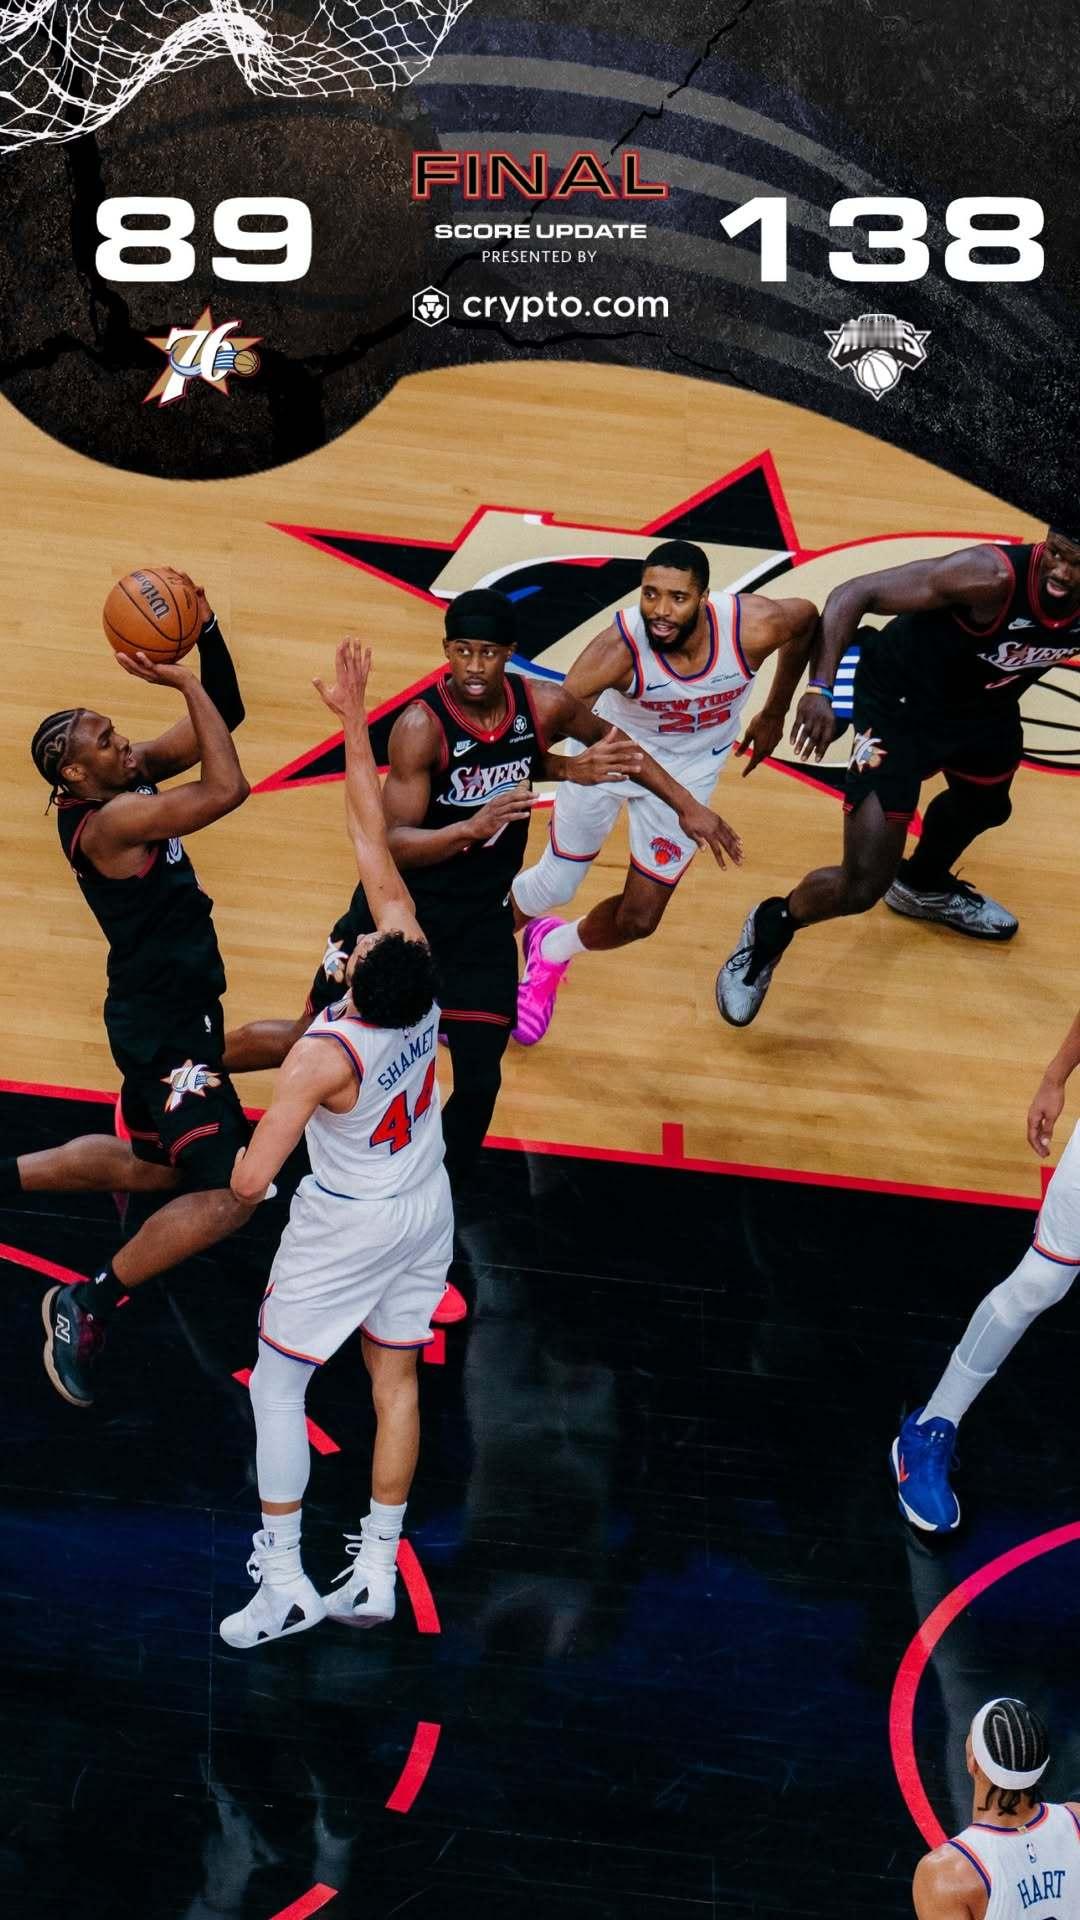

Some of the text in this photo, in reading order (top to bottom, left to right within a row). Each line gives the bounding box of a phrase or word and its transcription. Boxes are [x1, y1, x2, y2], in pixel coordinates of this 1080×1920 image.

[130, 570, 170, 619] Wilson
[640, 682, 750, 711] NEW YORK
[658, 703, 732, 733] 25
[378, 1024, 436, 1092] SHAMET
[369, 1056, 436, 1156] 44
[55, 1313, 72, 1345] N
[1017, 1869, 1067, 1909] HART
